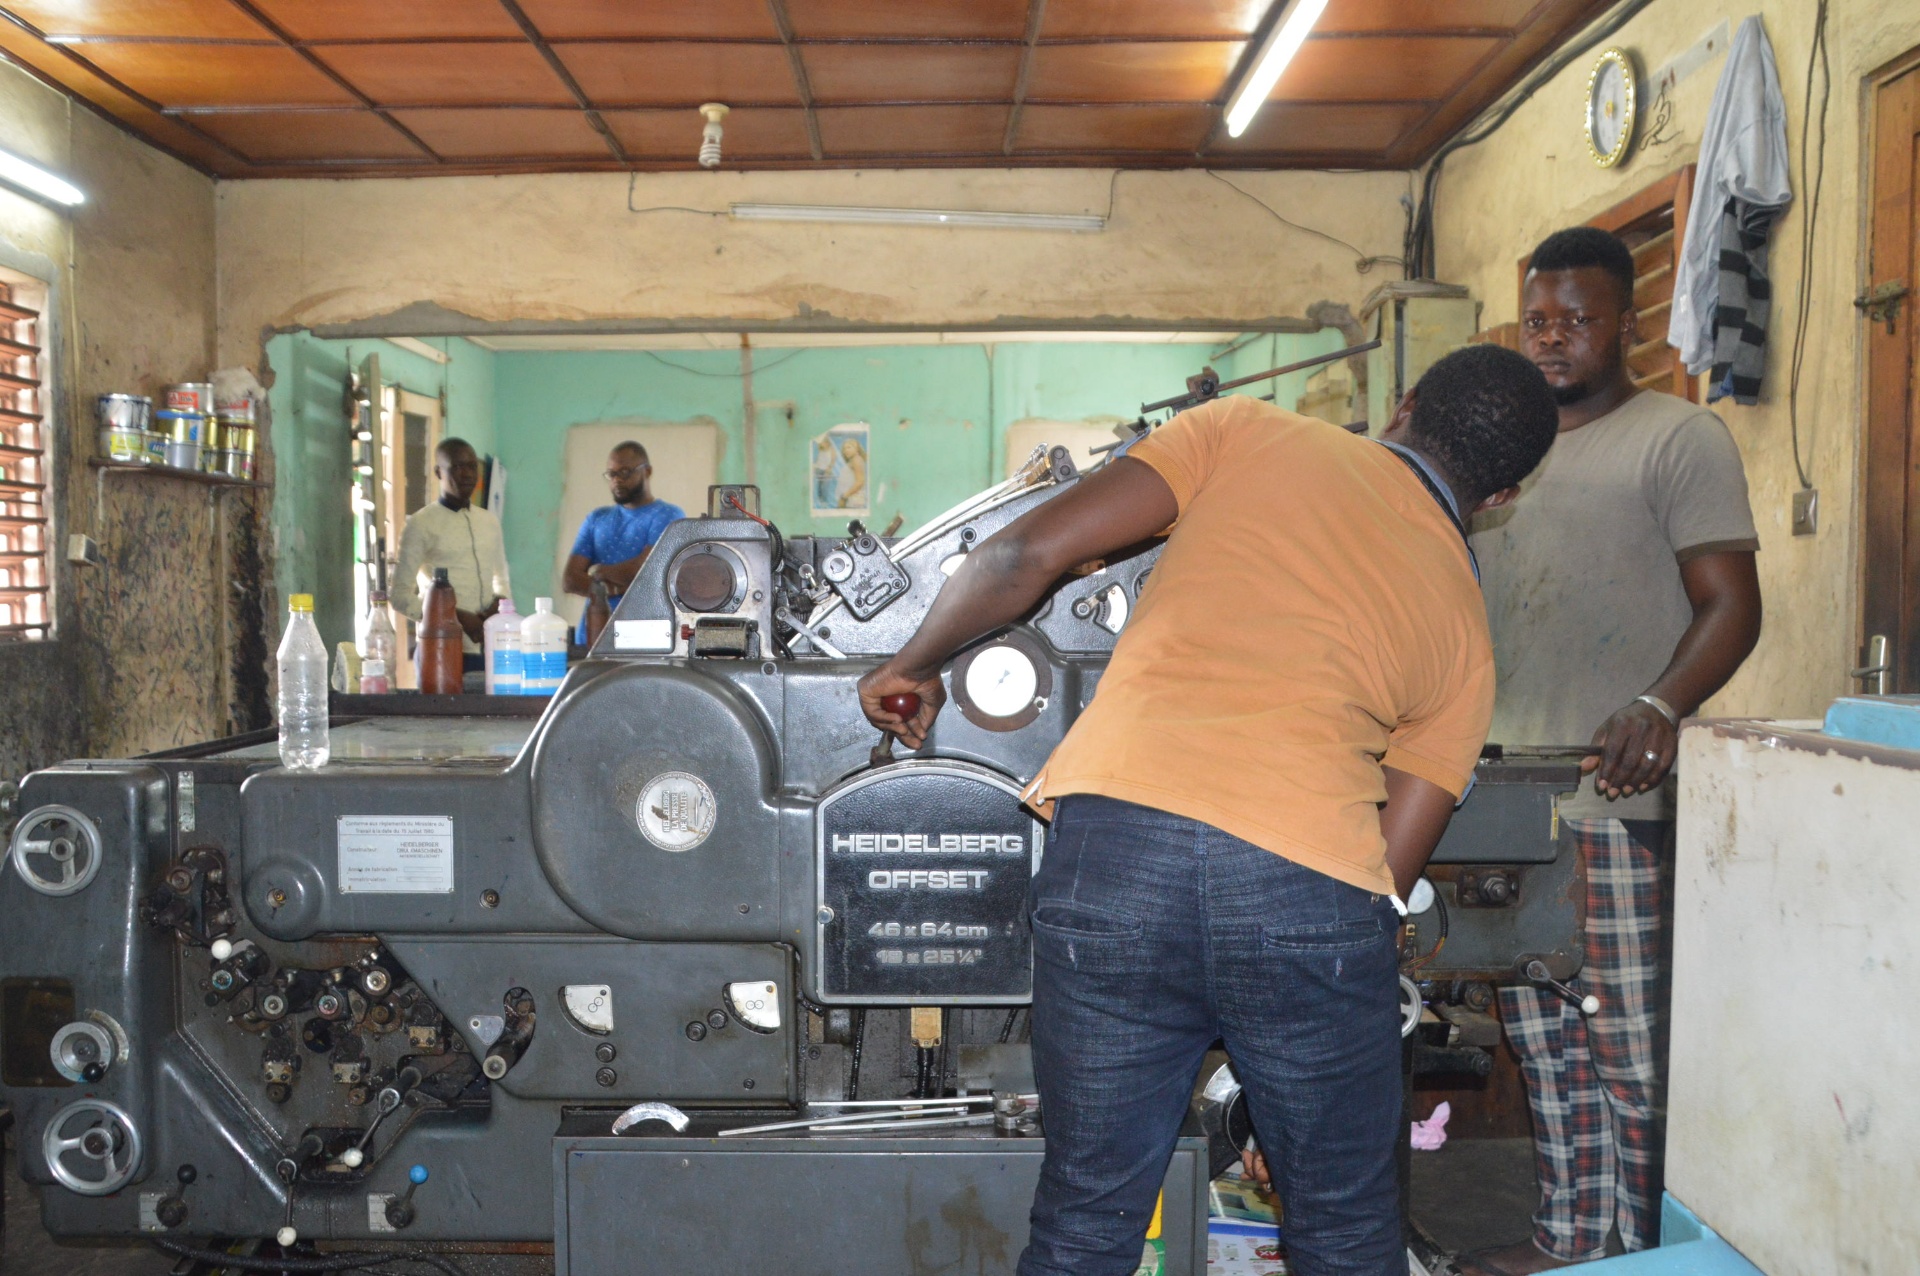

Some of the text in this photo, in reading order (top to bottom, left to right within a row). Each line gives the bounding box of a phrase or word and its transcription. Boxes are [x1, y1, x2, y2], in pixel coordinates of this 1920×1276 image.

[672, 820, 679, 829] LA
[681, 822, 688, 831] DE
[832, 834, 1023, 853] HEIDELBERG
[868, 870, 989, 889] OFFSET
[868, 922, 989, 937] 46 x 64 cm
